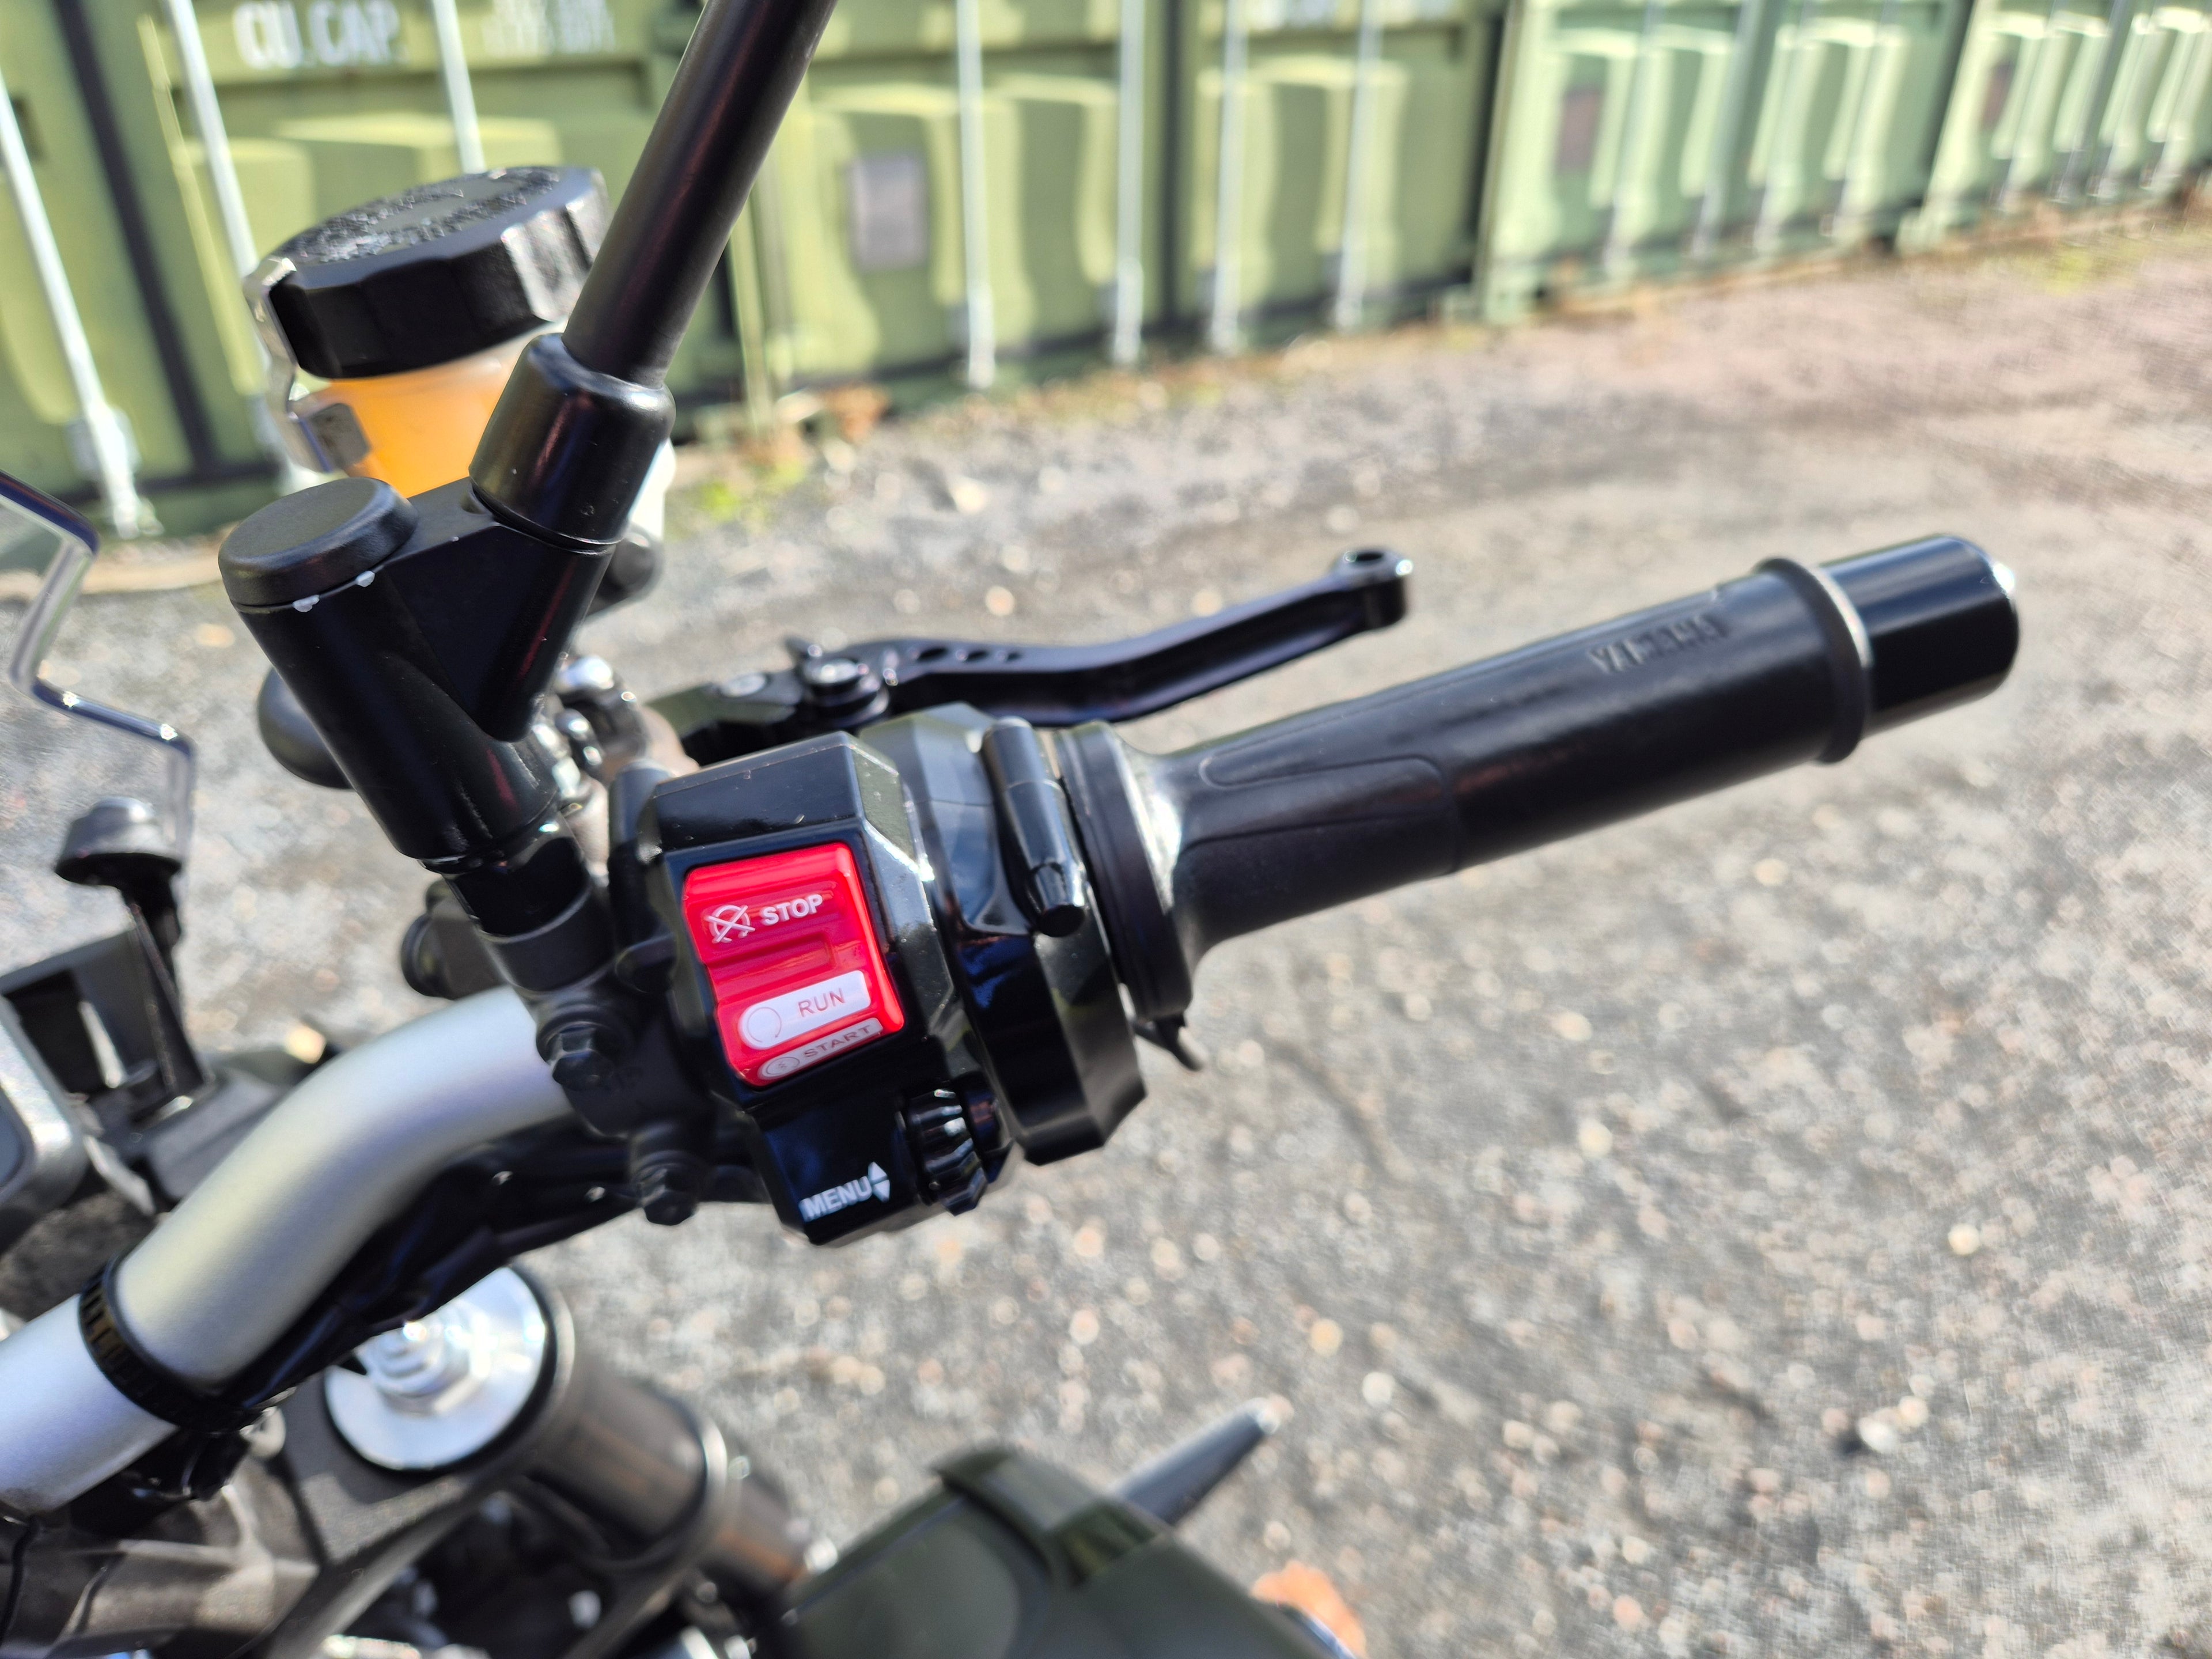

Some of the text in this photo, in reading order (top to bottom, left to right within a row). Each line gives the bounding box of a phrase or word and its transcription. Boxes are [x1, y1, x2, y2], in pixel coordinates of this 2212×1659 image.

[761, 893, 823, 926] STOP
[798, 988, 845, 1018] RUN
[804, 1024, 871, 1058] START
[800, 1176, 873, 1222] MENU
